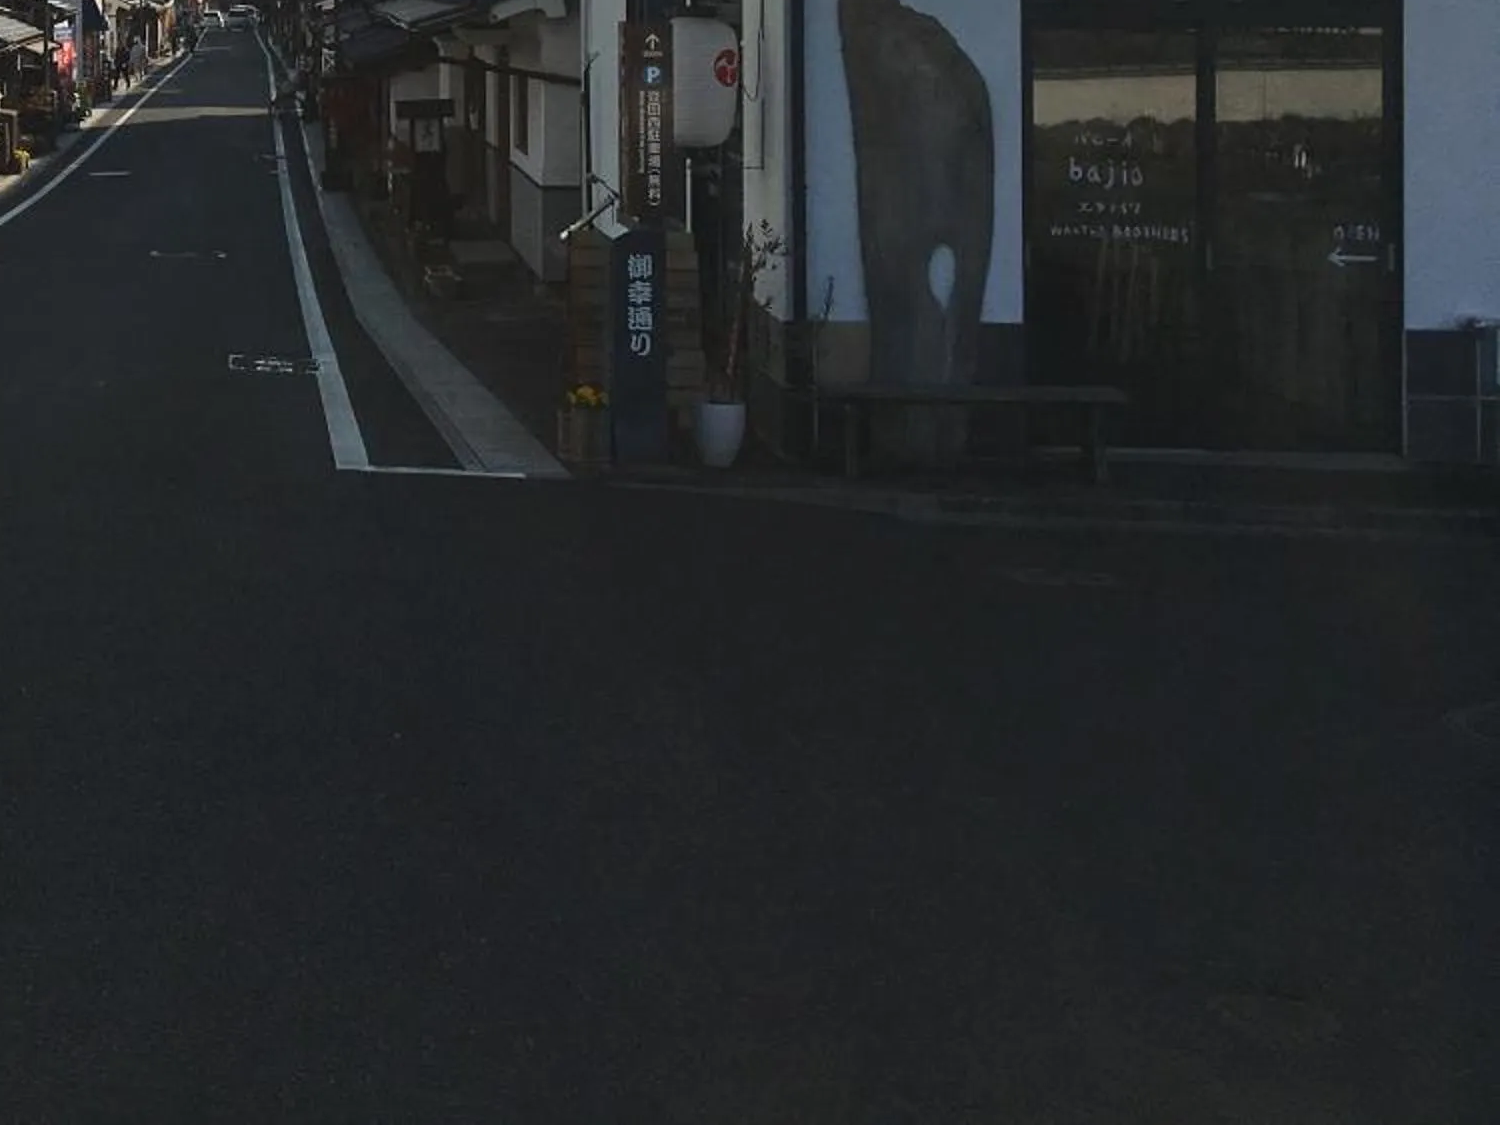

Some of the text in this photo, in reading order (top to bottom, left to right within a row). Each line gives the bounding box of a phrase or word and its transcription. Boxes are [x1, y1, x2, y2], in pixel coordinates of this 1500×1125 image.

[648, 66, 661, 84] P
[1067, 155, 1144, 192] bajio
[627, 252, 654, 357] 御幸通り
